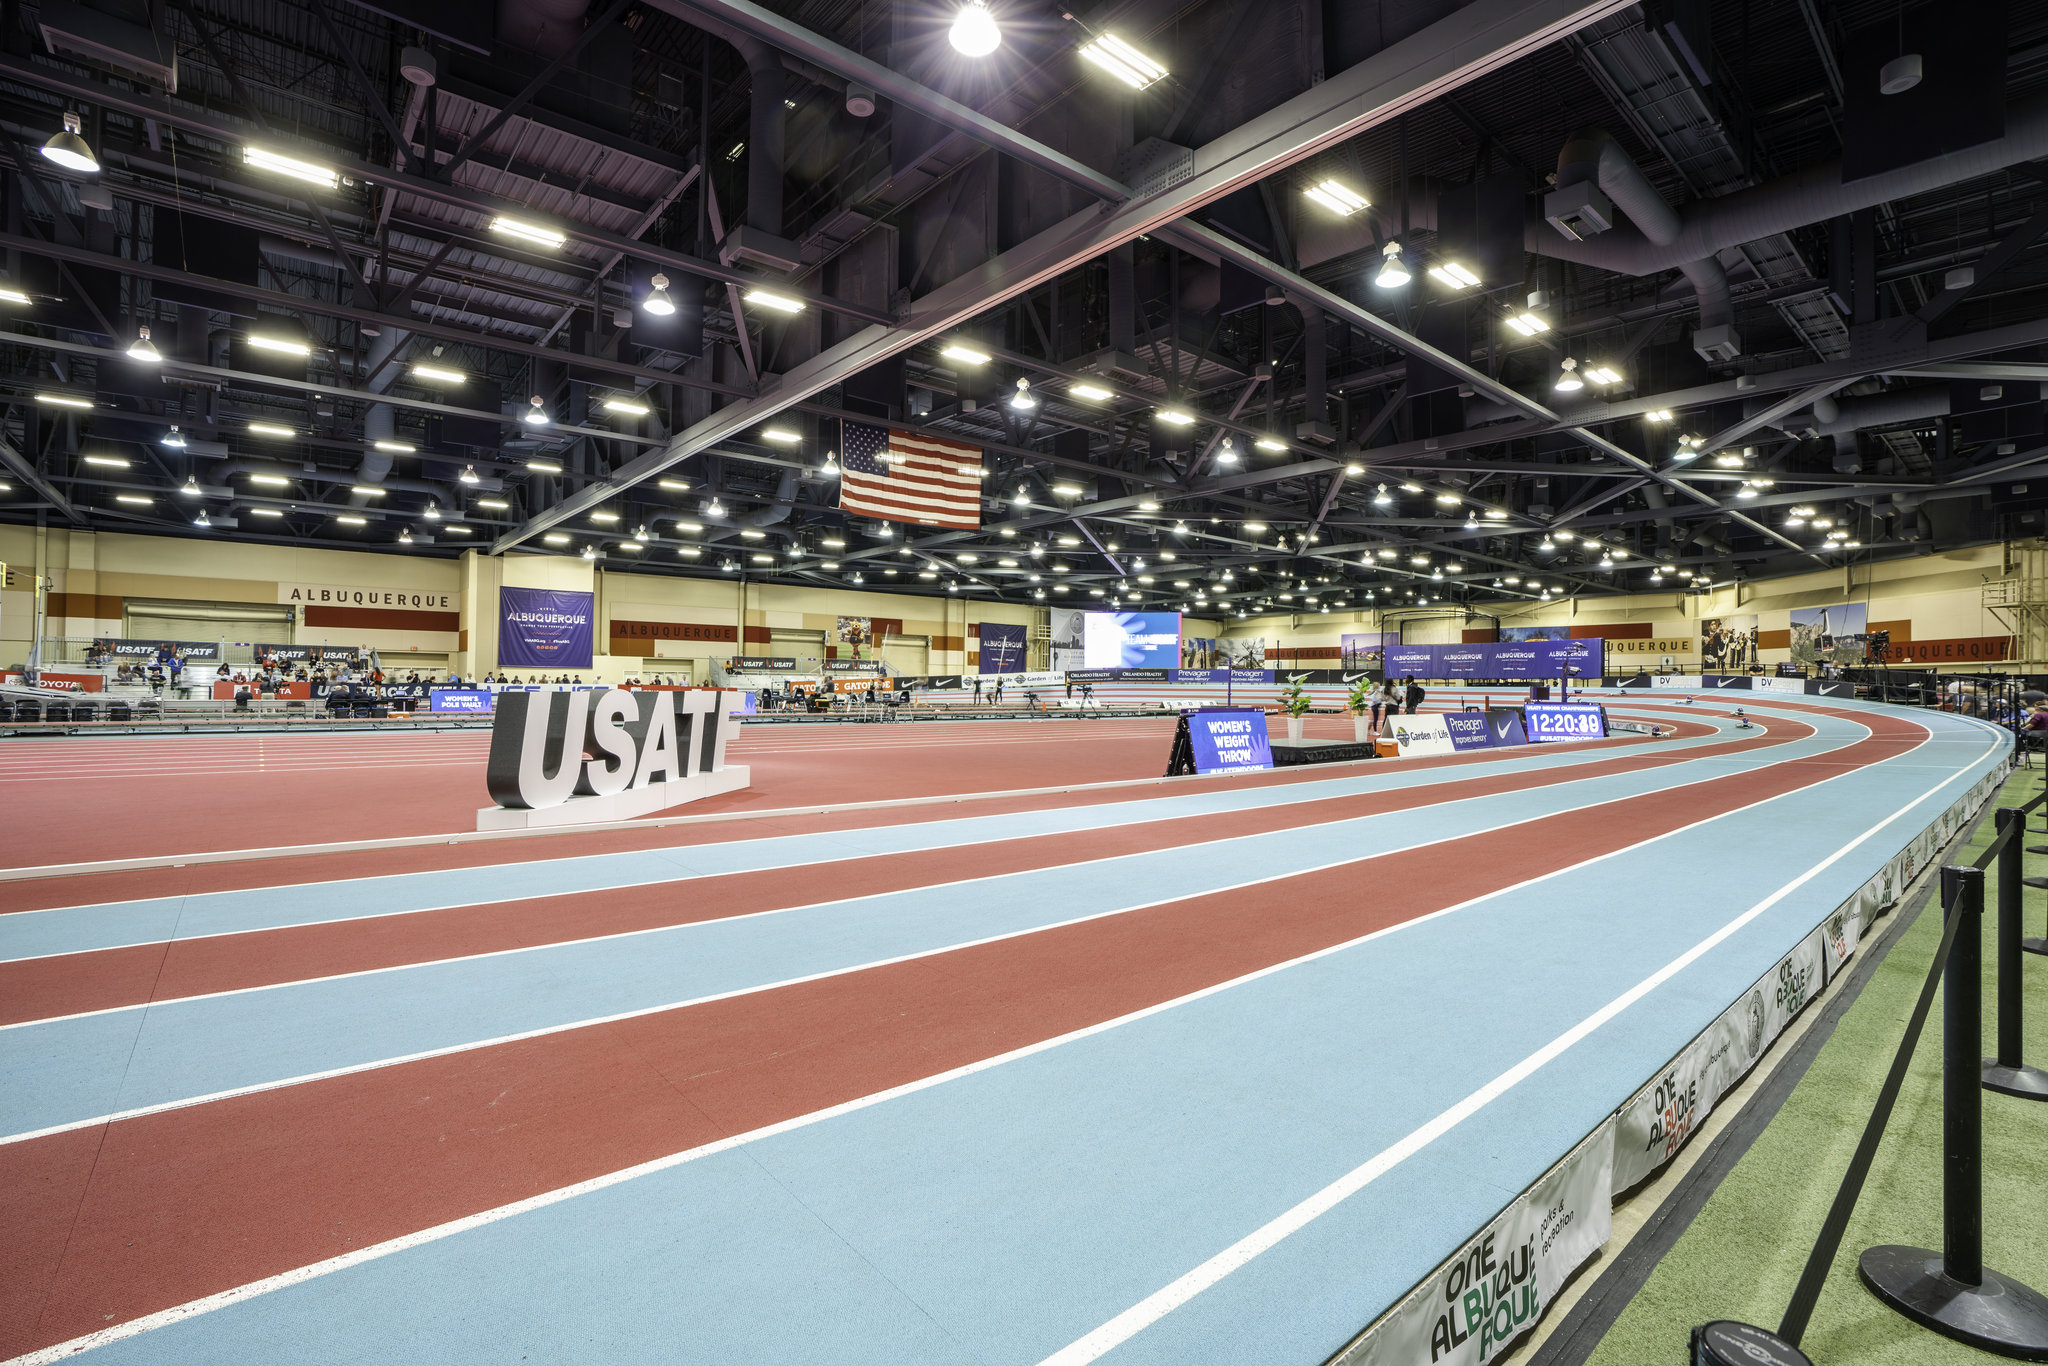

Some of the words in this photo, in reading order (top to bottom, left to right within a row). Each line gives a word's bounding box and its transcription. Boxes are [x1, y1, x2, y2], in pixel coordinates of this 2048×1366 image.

[291, 588, 448, 608] ALBUQUERQUE
[507, 612, 586, 624] ALBUQUERQUE
[620, 624, 730, 639] ALBUQUERQUE
[116, 645, 155, 654] USATF
[1178, 669, 1211, 678] Prevagen
[1231, 669, 1264, 678] Prevagen
[39, 680, 78, 688] OYOTA
[360, 686, 410, 698] TRACK
[413, 686, 424, 697] &
[1207, 720, 1252, 734] WOMEN'S
[1449, 717, 1484, 735] Prevagen
[1213, 734, 1250, 748] WEIGHT
[1409, 731, 1432, 742] Garden
[1431, 728, 1438, 743] of
[1437, 729, 1449, 739] Life
[518, 689, 746, 809] USATF
[1217, 749, 1251, 763] THROW
[1655, 1071, 1677, 1116] ONE
[1645, 1080, 1696, 1152] ALBUQUE
[1540, 1206, 1557, 1241] parks
[1558, 1198, 1565, 1212] &
[1541, 1209, 1574, 1258] recreation
[1446, 1231, 1497, 1303] ONE
[1431, 1233, 1536, 1364] ALBUQUE
